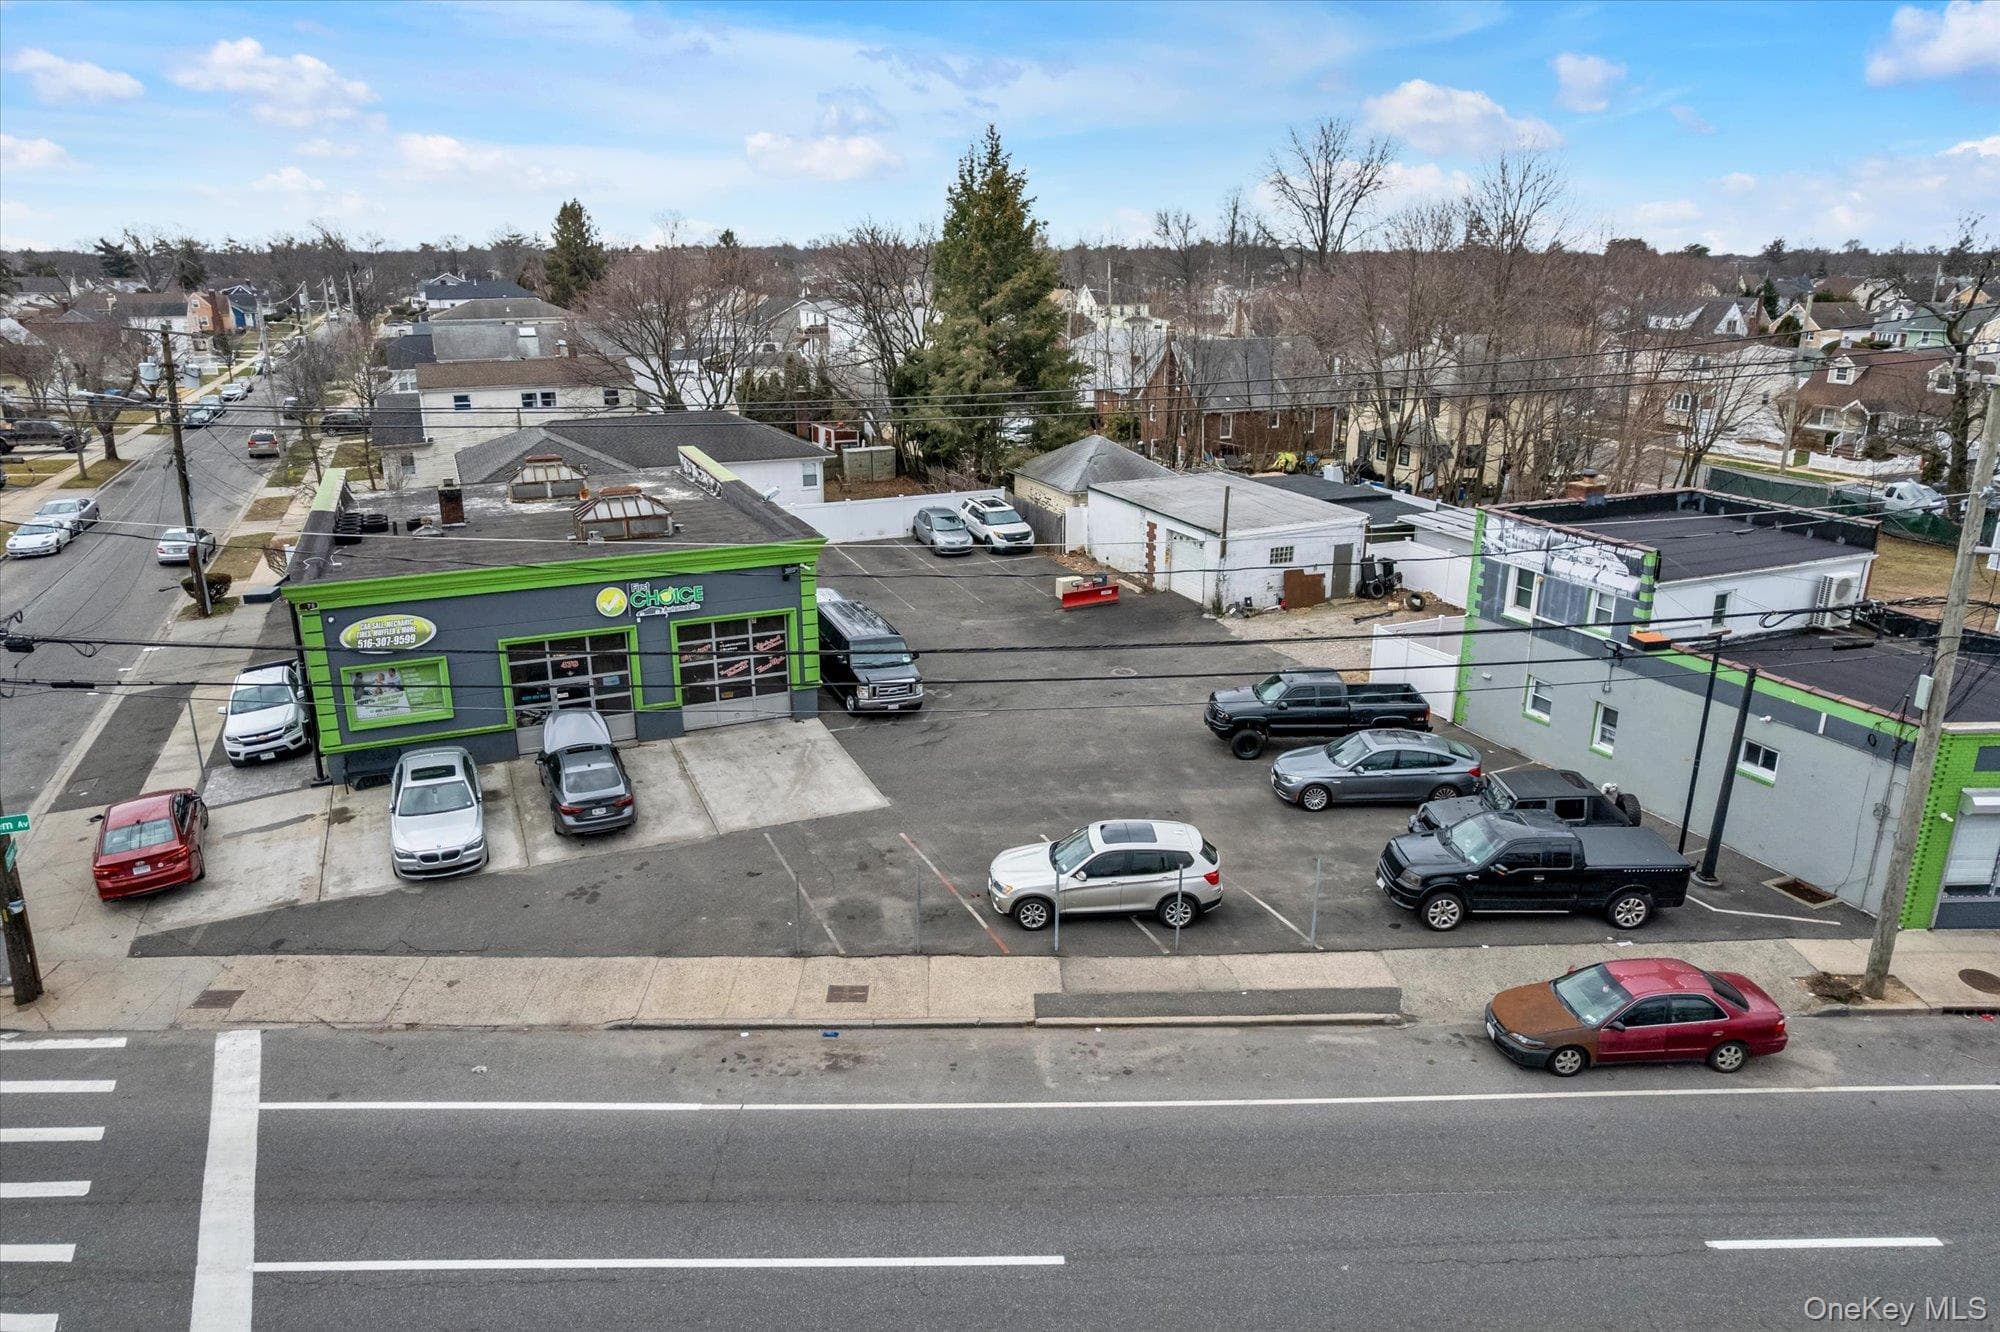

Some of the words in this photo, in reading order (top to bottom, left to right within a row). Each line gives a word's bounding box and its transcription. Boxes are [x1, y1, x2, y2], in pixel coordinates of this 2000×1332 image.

[630, 582, 650, 593] First
[630, 586, 703, 608] CHOICE
[357, 633, 417, 649] 516-307-9599
[18, 820, 29, 828] Av
